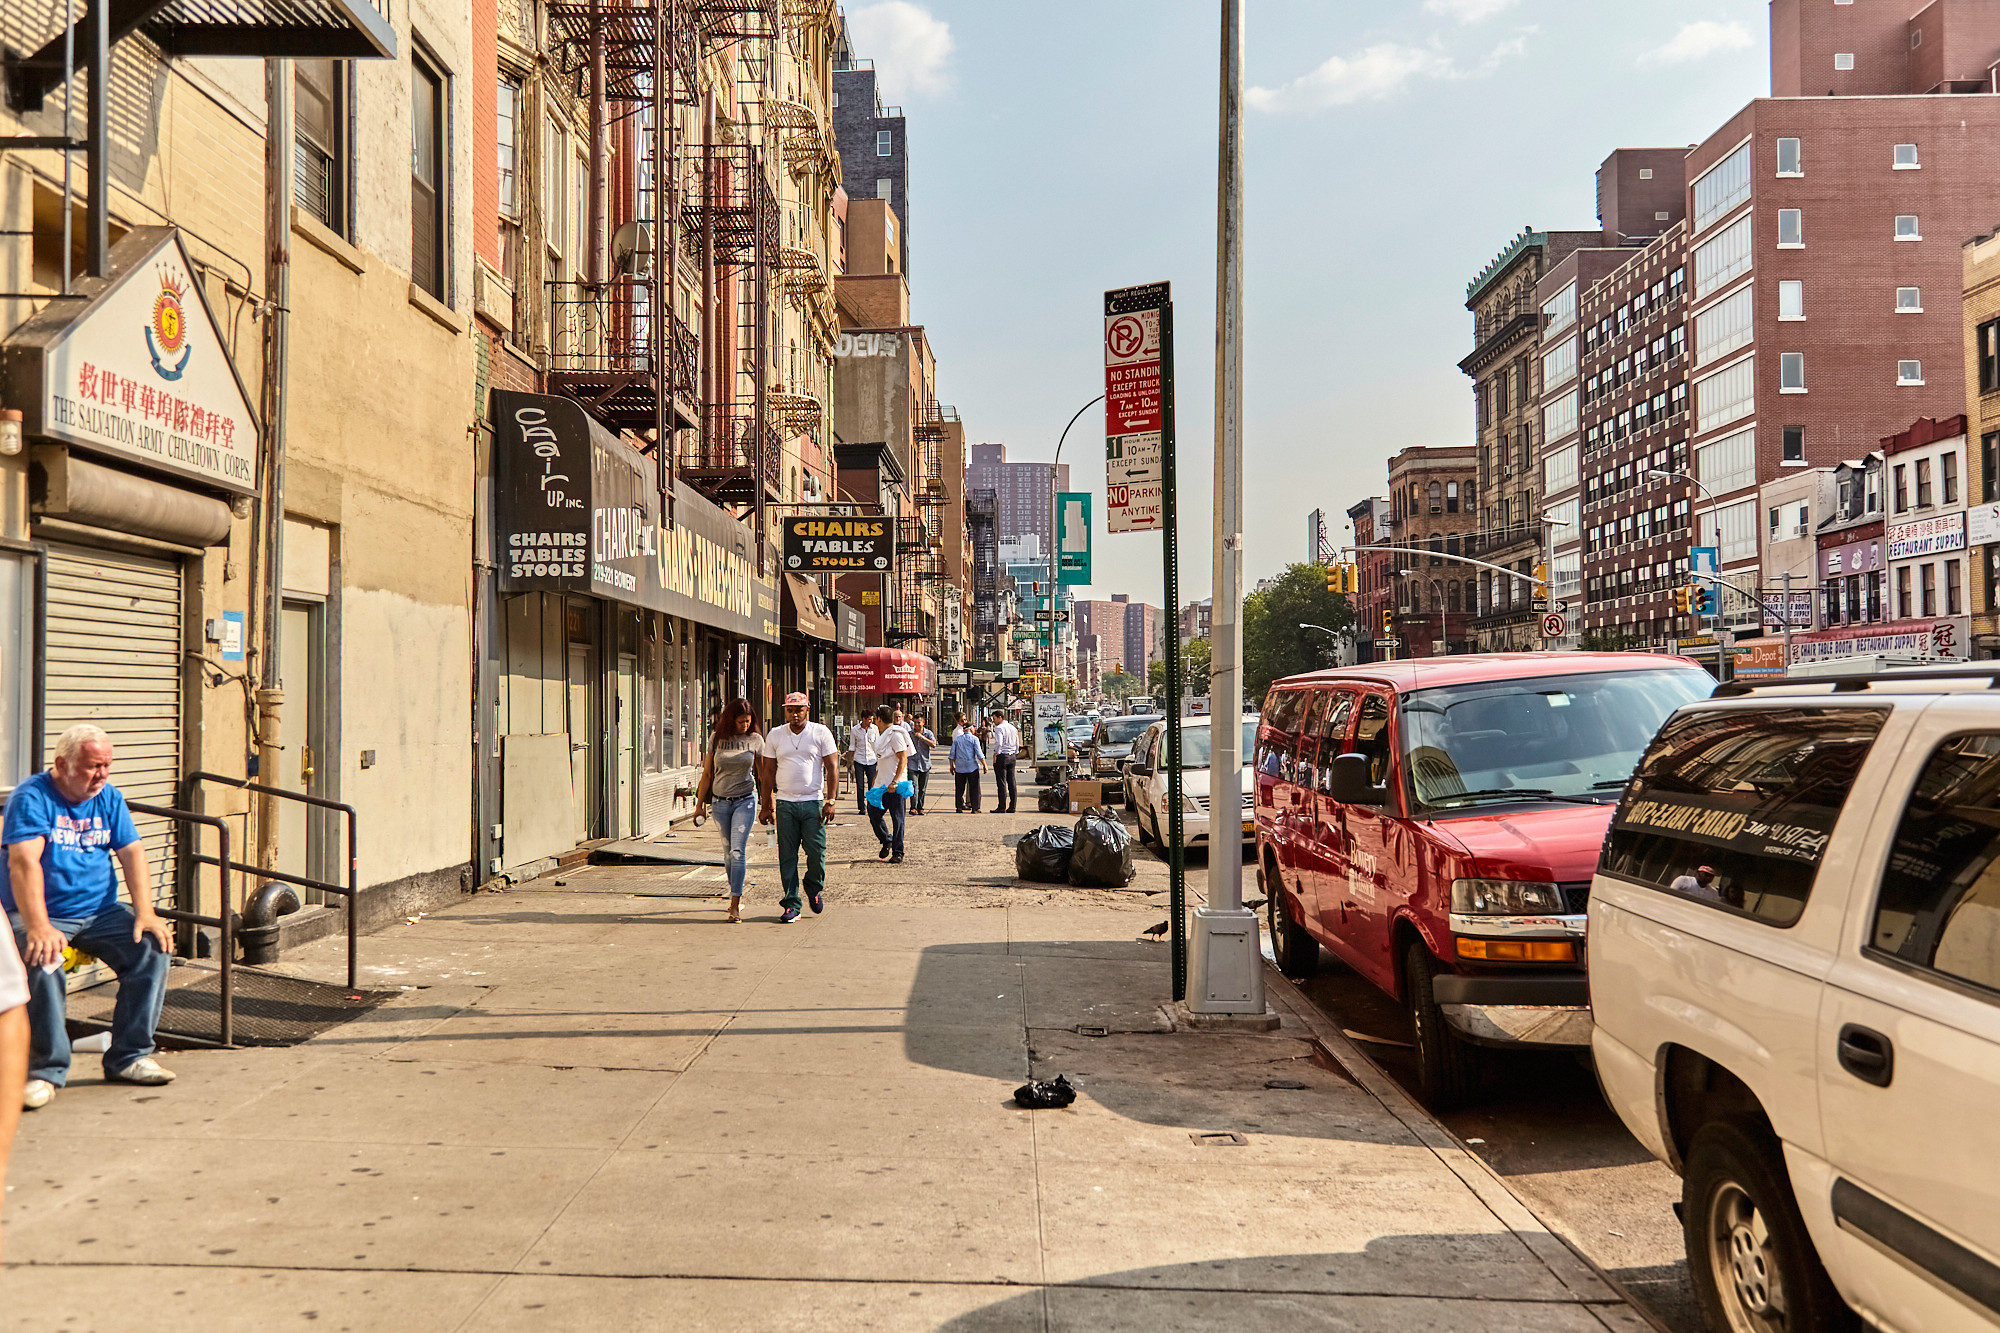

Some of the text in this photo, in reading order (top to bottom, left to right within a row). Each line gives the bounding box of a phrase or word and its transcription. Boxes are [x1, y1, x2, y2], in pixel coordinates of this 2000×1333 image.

[1113, 286, 1163, 300] NIGHT REGULATION
[1141, 310, 1160, 320] MIDNIG
[1110, 365, 1160, 381] NO STANDIN
[1112, 379, 1160, 392] EXCEPT TRUCK
[1109, 391, 1132, 400] LOADING
[1138, 388, 1160, 397] UNLOADI
[1118, 408, 1159, 418] EXCEPT SUNDAY
[53, 395, 251, 483] THE SALVATION ARMY CHINATOWN CORPS.
[1112, 438, 1117, 457] 1
[1112, 456, 1162, 468] EXCEPT SUNDA
[547, 491, 585, 509] UP INC.
[1109, 486, 1162, 505] NO PARKIN
[1121, 505, 1160, 516] ANYTIME
[594, 507, 628, 562] CHAIR
[628, 507, 642, 557] UP
[793, 521, 884, 537] CHAIRS
[509, 533, 587, 546] CHAIRS
[802, 540, 875, 553] TABLES
[1889, 532, 1963, 557] RESTAURANT SUPPLY
[509, 548, 586, 562] TABLES
[812, 557, 865, 567] STOOLS
[511, 563, 585, 577] STOOLS
[614, 570, 637, 592] BOWERY
[1013, 631, 1041, 639] RIVINGTON
[1801, 644, 1816, 656] CHAIR
[1818, 642, 1833, 655] TABLE
[1835, 639, 1852, 654] BOOTH
[1856, 636, 1893, 652] RESTAURANT
[1894, 634, 1916, 649] SUPPLY
[1755, 647, 1777, 667] Depot
[899, 681, 914, 690] 213
[1350, 839, 1377, 882] Bowery
